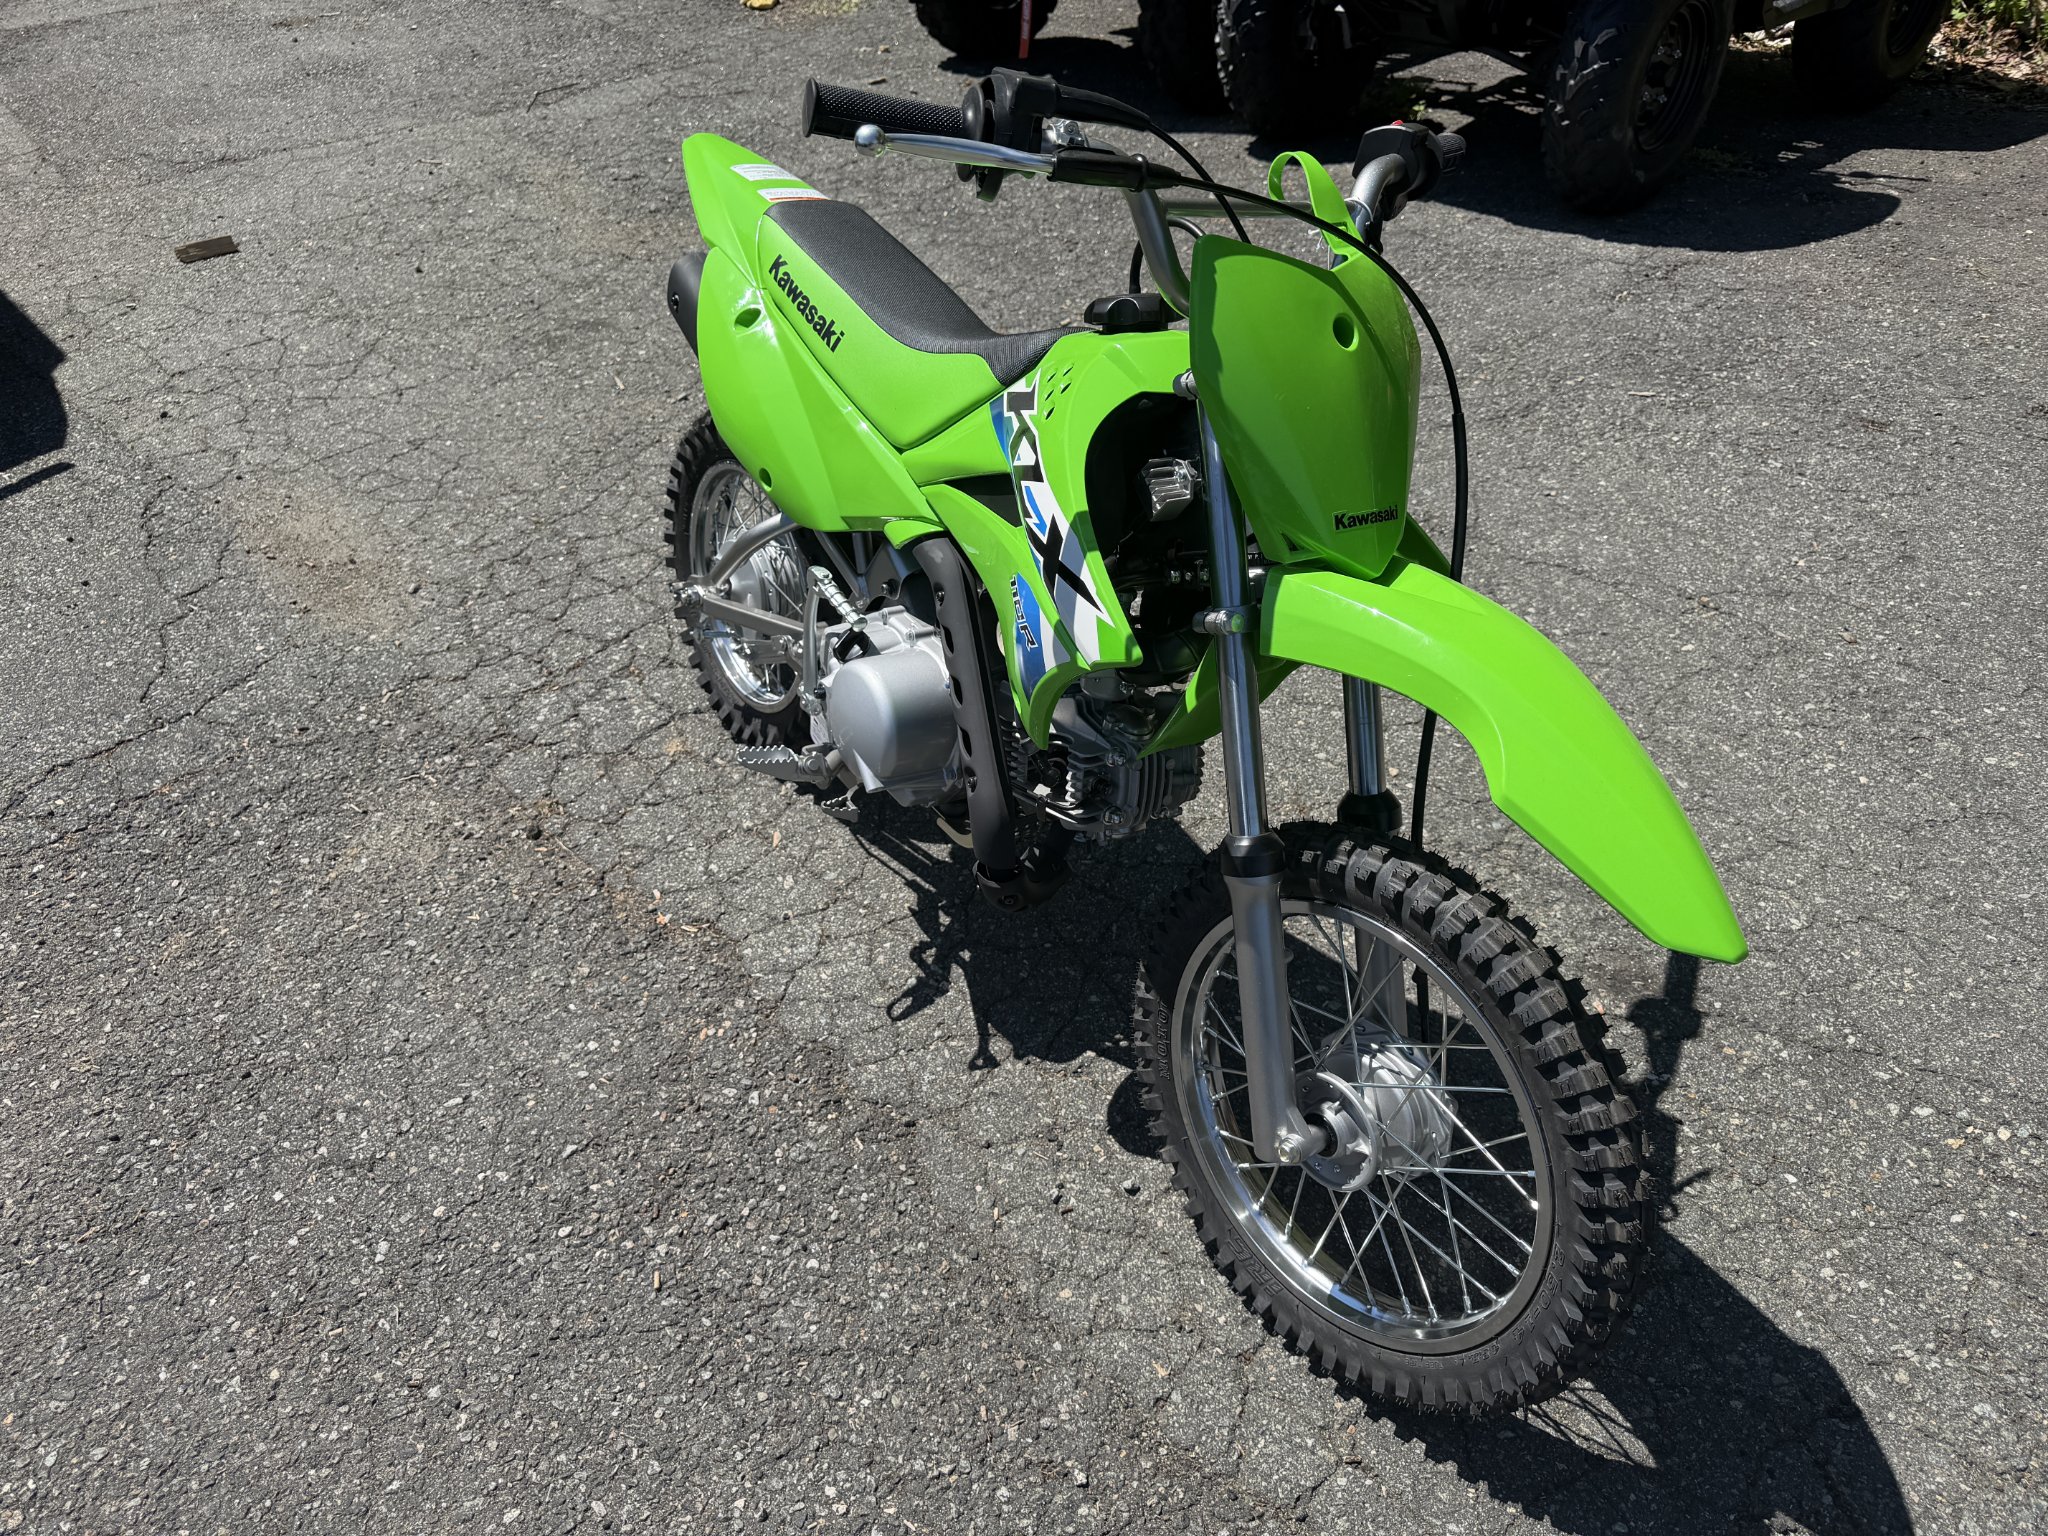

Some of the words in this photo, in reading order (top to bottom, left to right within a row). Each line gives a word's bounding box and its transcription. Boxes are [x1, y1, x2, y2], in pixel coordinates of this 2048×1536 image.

[768, 253, 845, 353] Kawasaki
[1005, 377, 1106, 618] KLX
[1334, 504, 1399, 531] Kawasaki
[1010, 575, 1039, 653] 110R
